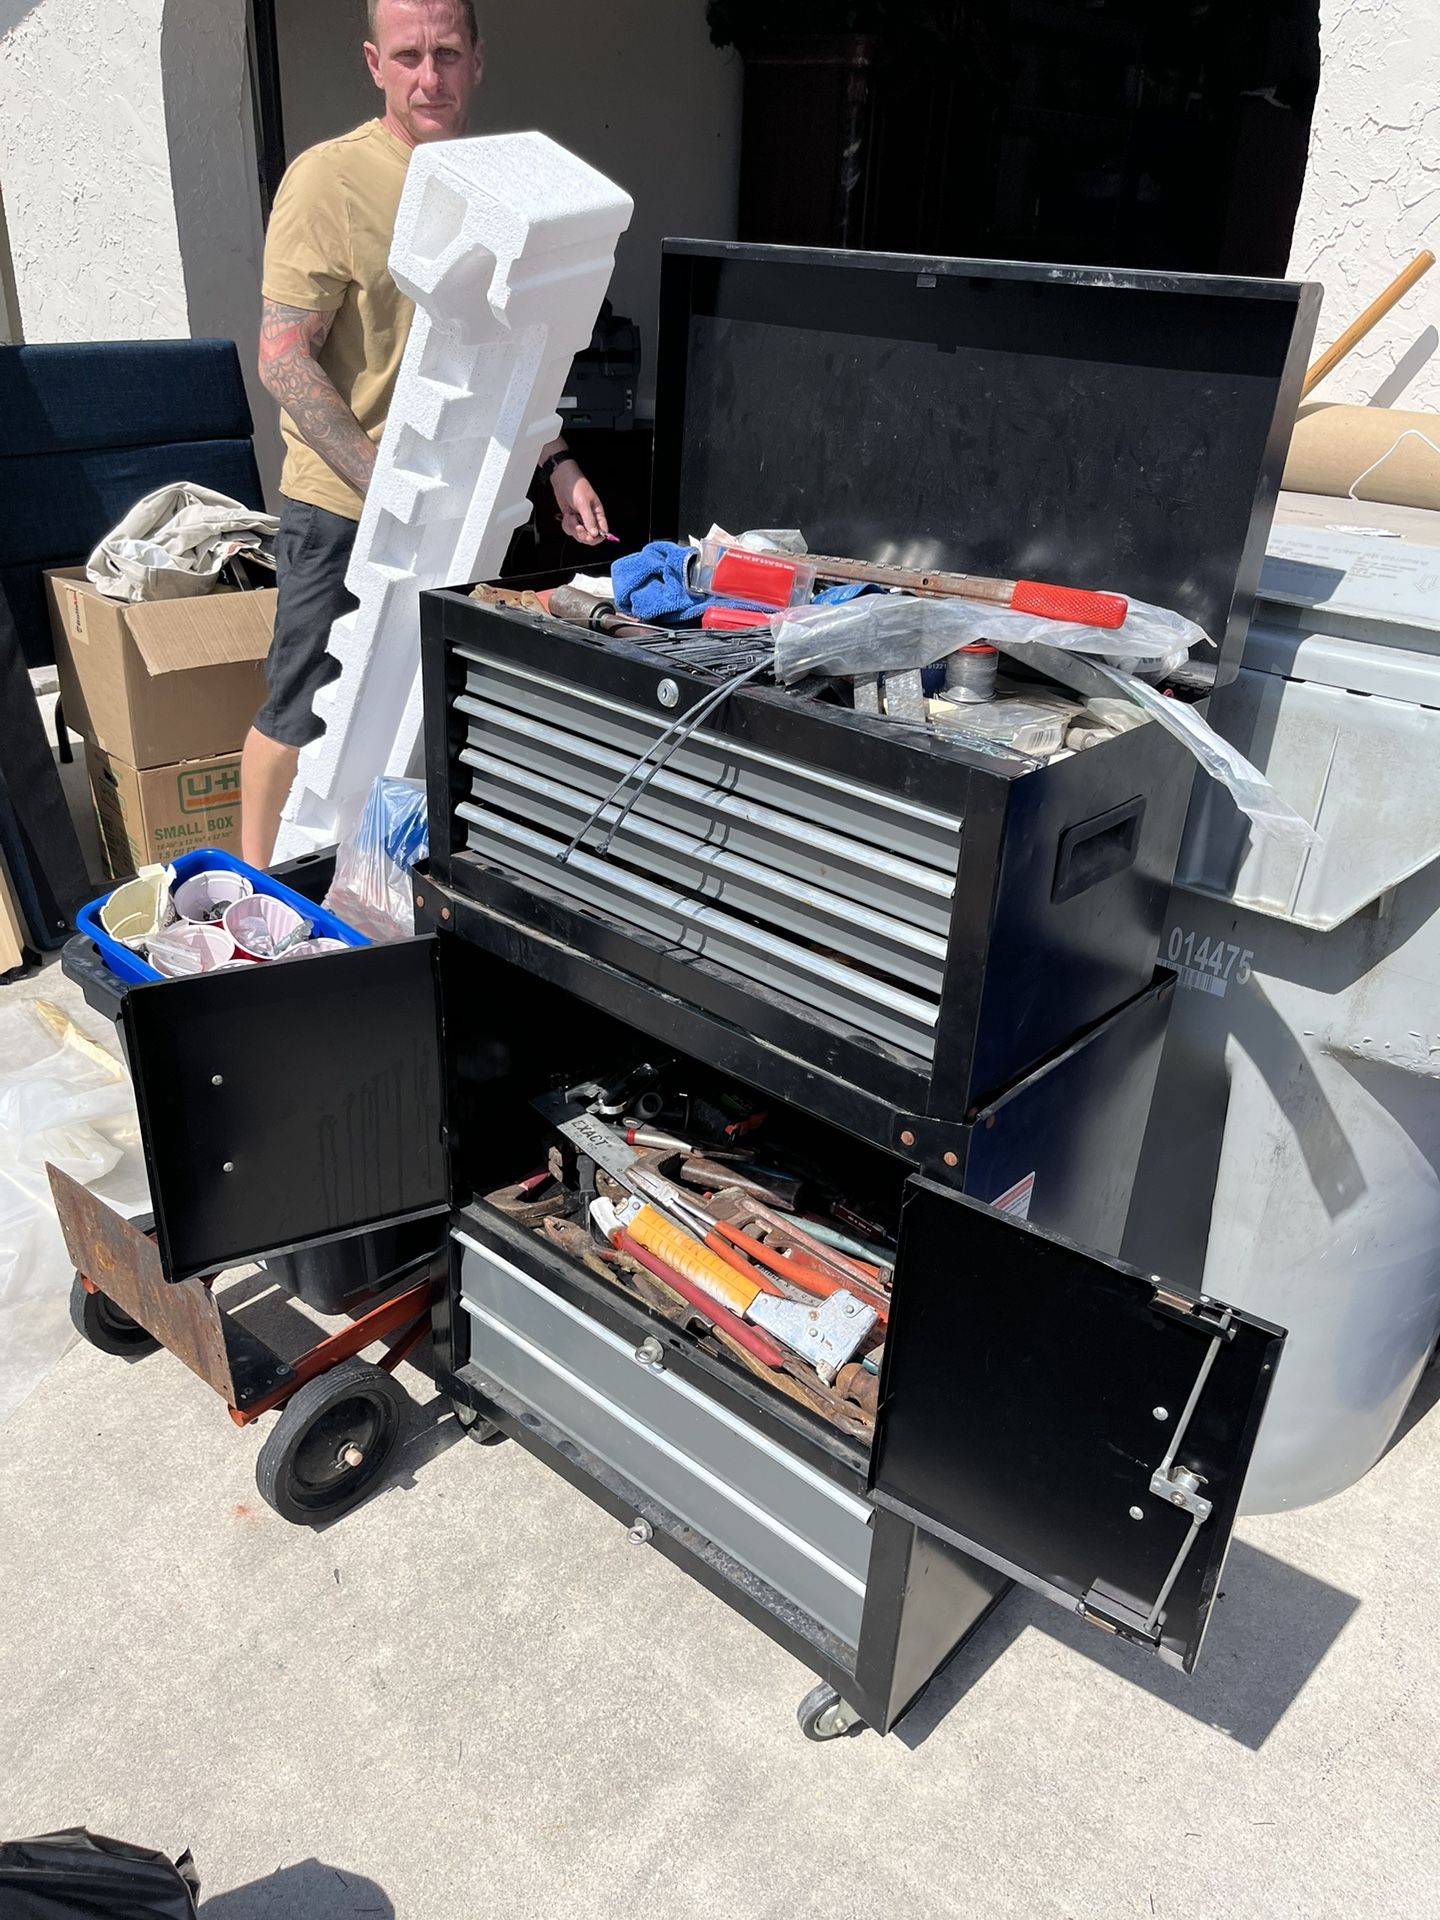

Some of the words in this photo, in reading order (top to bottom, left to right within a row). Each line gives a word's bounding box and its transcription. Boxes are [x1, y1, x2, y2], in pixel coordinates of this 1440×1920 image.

[188, 770, 240, 796] U-H
[154, 823, 202, 840] SMALL
[207, 815, 234, 832] BOX
[1168, 926, 1254, 985] 014475
[571, 1120, 609, 1148] EXACT
